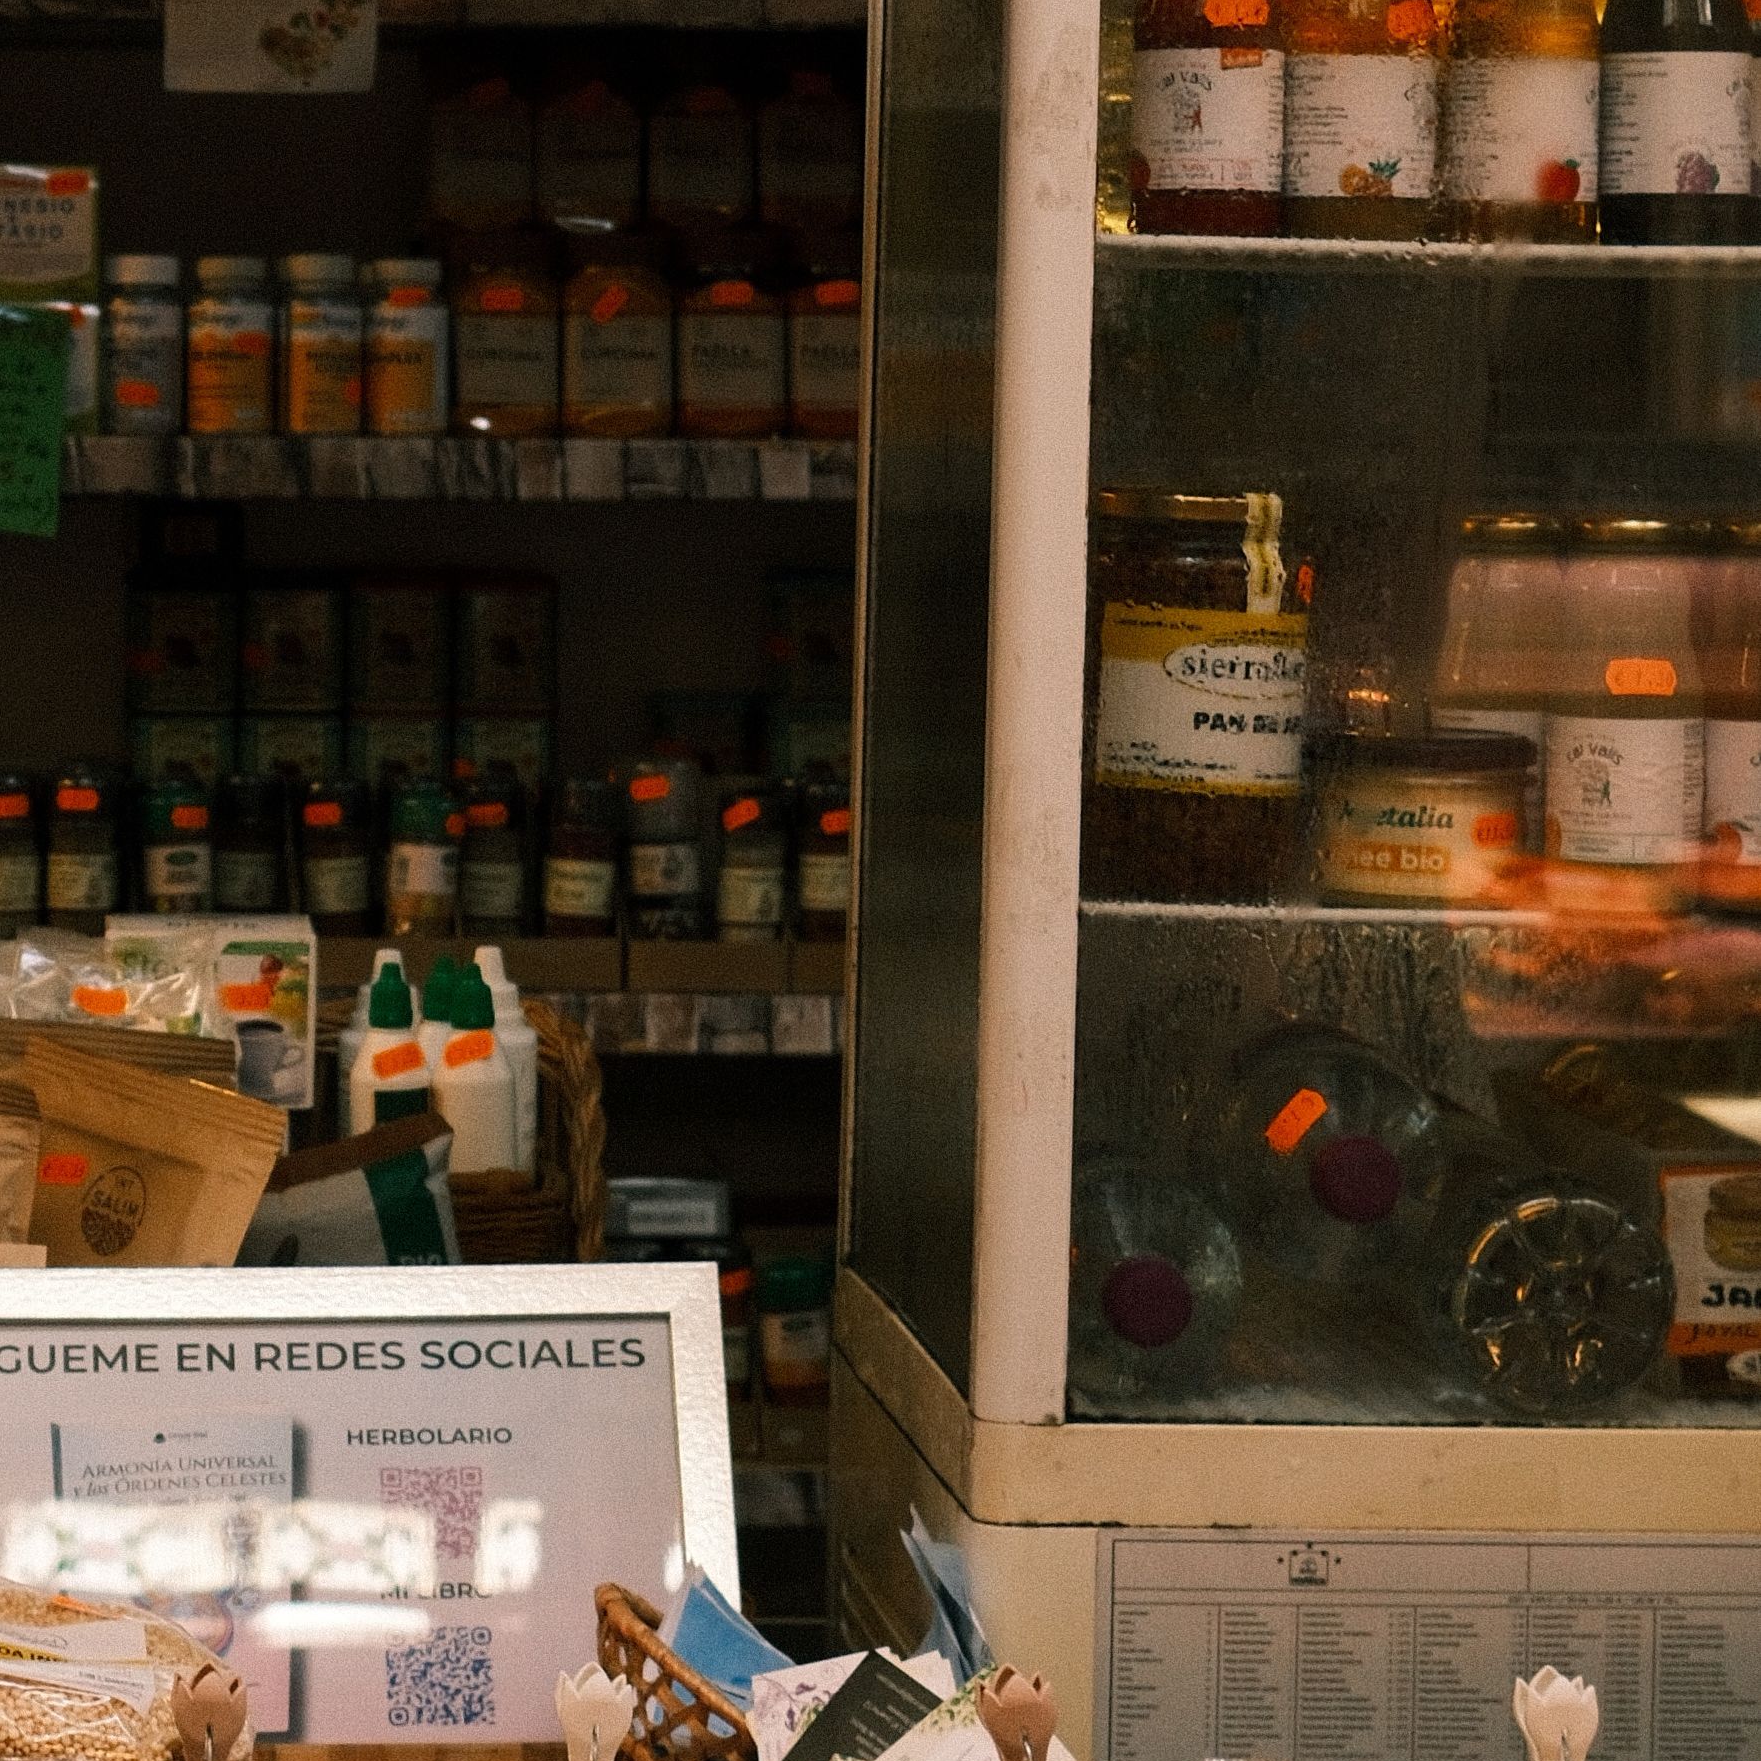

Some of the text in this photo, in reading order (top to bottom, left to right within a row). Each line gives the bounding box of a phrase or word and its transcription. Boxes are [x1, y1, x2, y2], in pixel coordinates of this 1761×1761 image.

[175, 1341, 238, 1373] EN
[254, 1340, 406, 1373] REDES
[420, 1337, 647, 1372] SOCIALES
[346, 1426, 513, 1446] HERBOLARIO
[81, 1453, 277, 1480] ARMONÍA UNIVERSAL
[205, 1471, 286, 1488] CELESTES
